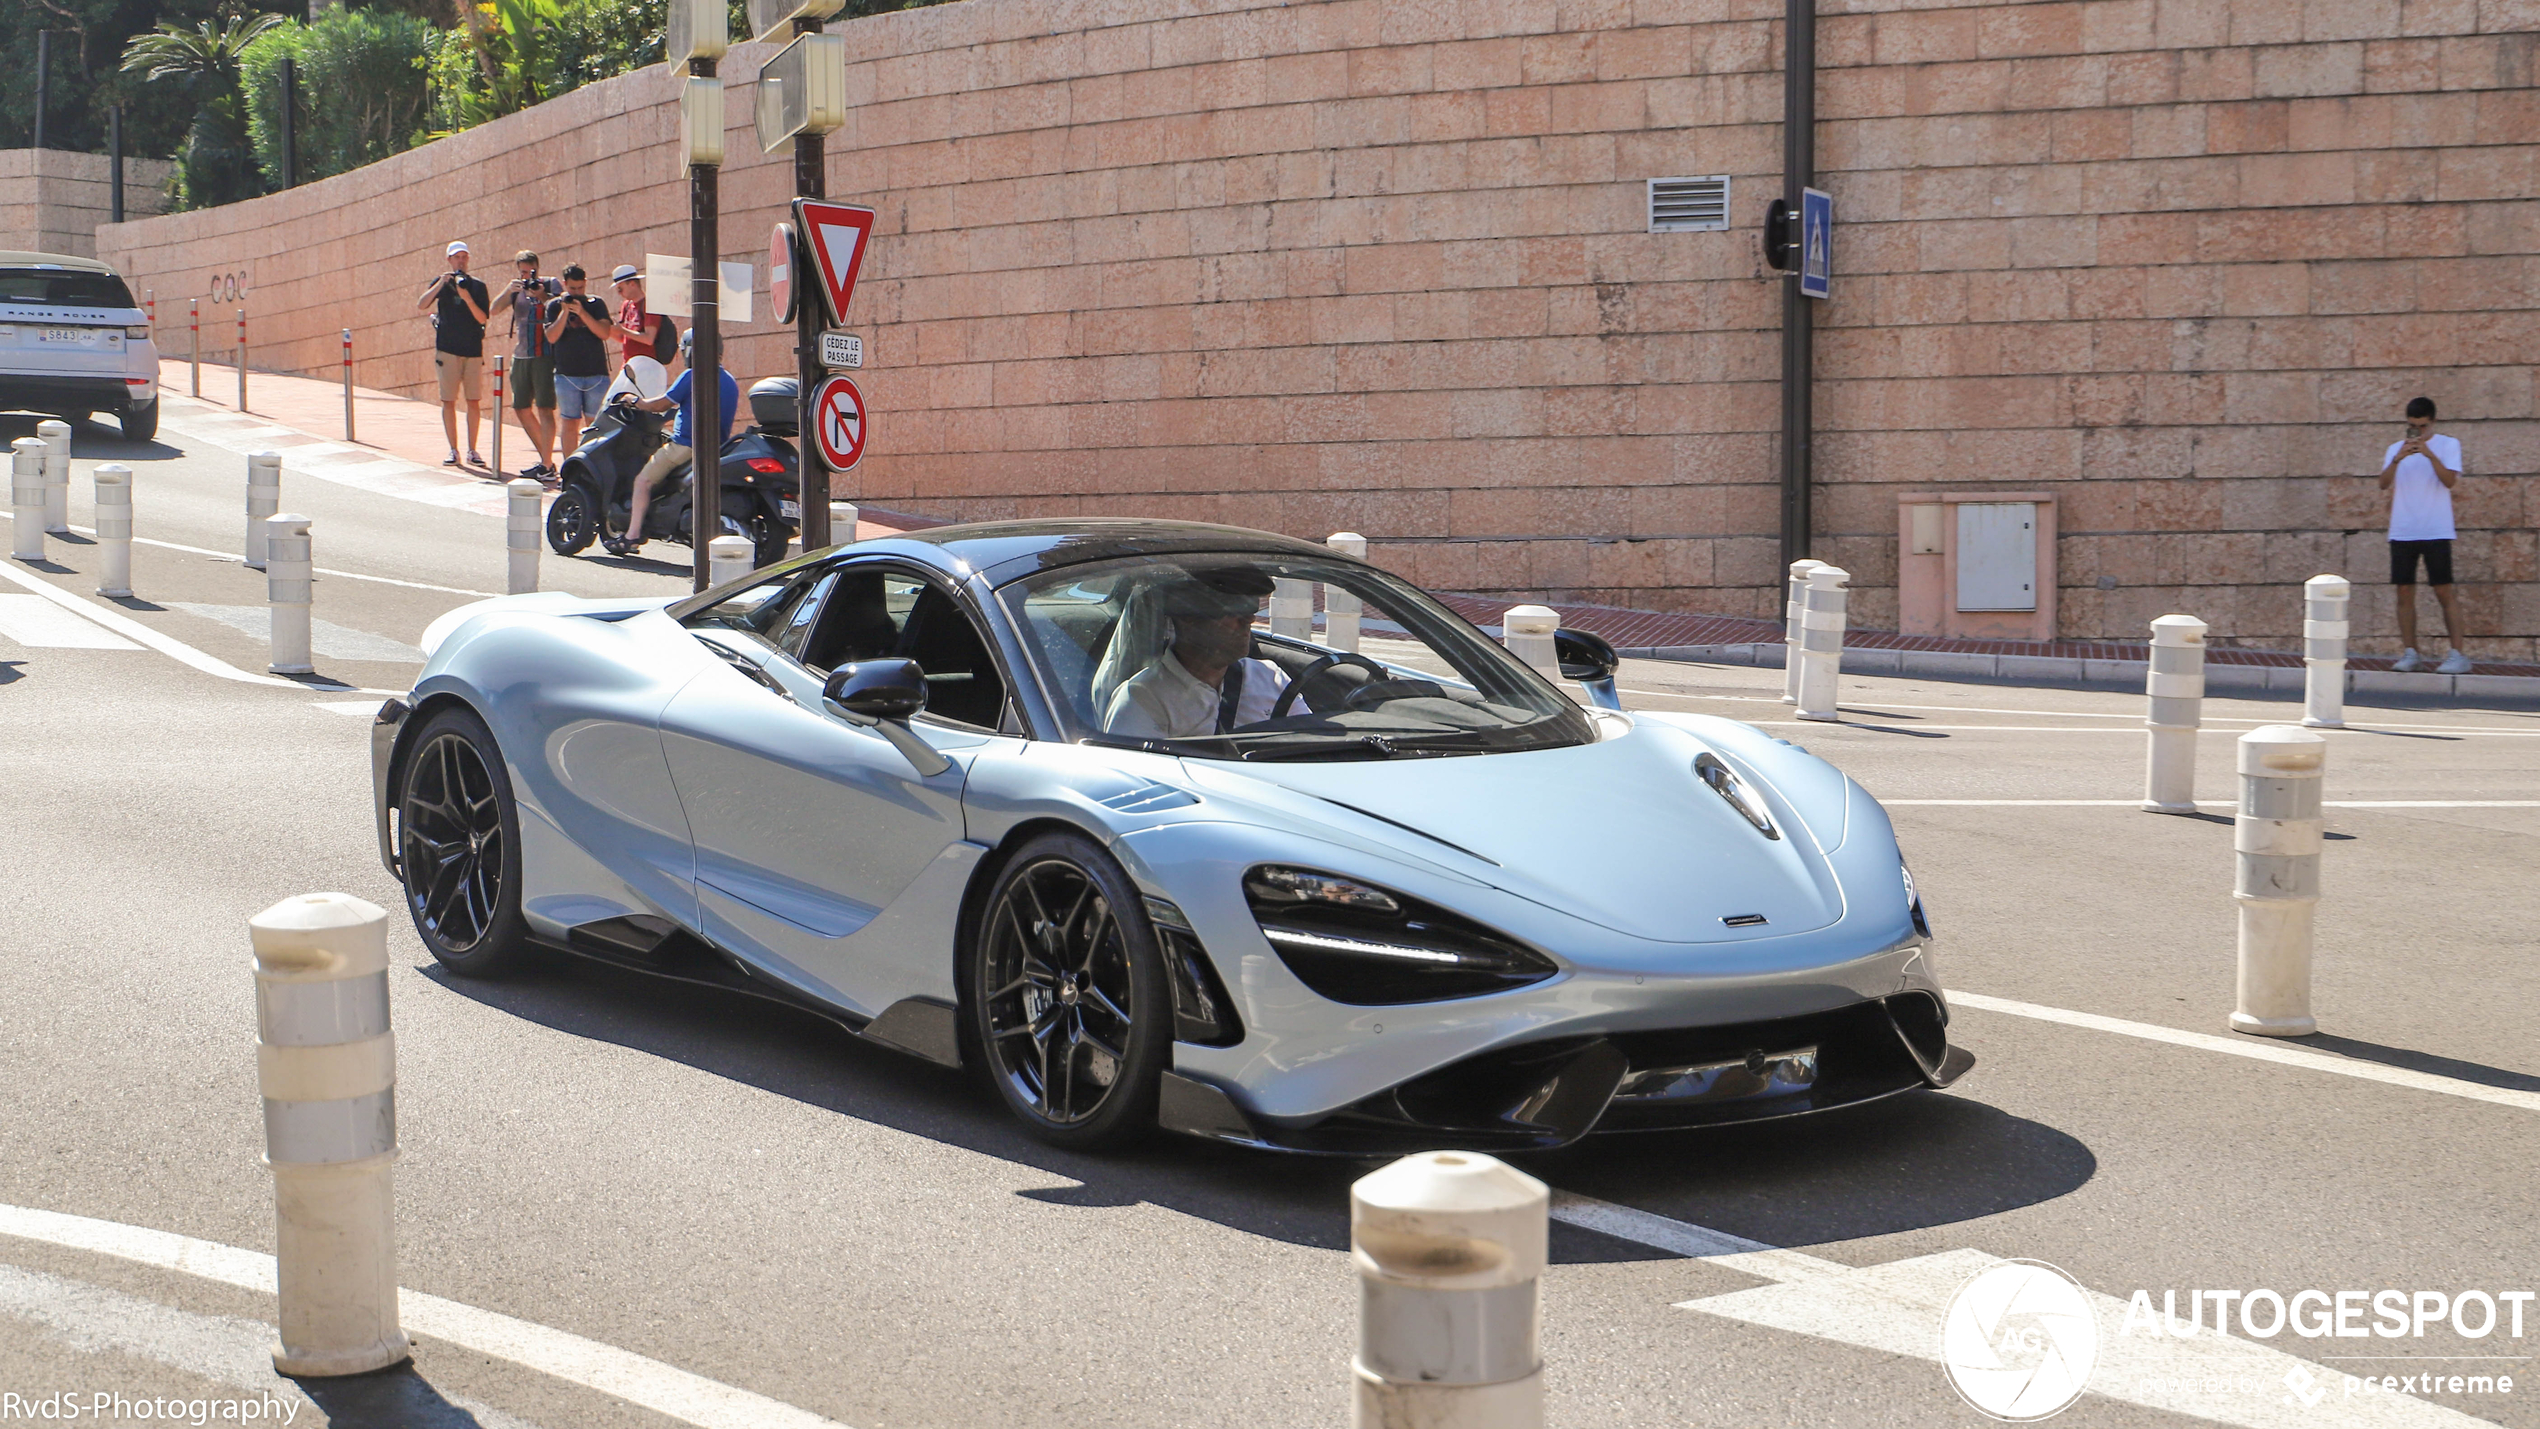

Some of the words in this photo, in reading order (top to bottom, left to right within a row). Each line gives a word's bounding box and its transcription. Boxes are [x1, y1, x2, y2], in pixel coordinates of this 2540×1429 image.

[49, 330, 76, 340] S843
[827, 336, 847, 349] CÉDEZ
[851, 341, 858, 350] LE
[828, 351, 857, 363] PASSAGE
